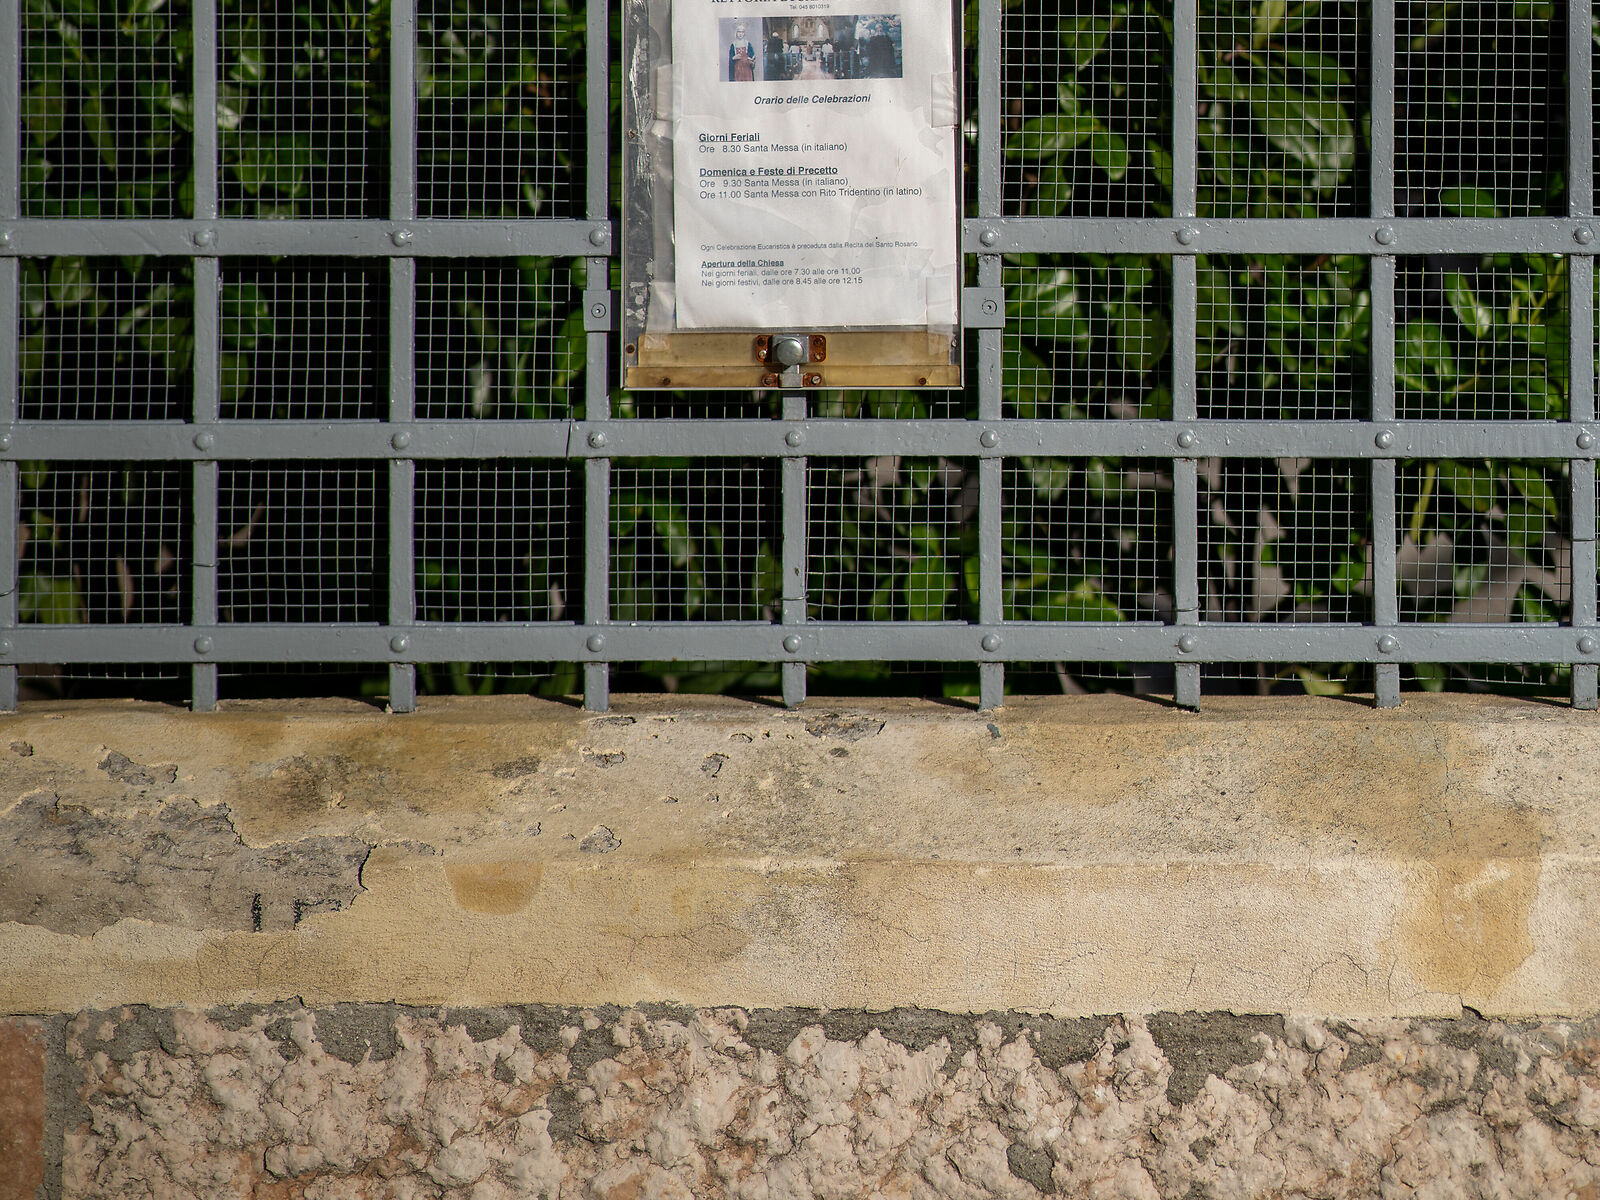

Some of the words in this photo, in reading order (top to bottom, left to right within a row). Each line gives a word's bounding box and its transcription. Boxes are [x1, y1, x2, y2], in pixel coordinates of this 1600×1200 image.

[754, 96, 784, 104] Orario
[786, 95, 809, 104] delle
[812, 94, 872, 104] Celebrazioni
[698, 133, 728, 142] Giorni
[730, 132, 760, 142] Feriali
[699, 144, 715, 153] Ore
[722, 144, 741, 152] 8.30
[744, 144, 768, 152] Santa
[770, 144, 799, 152] Messa
[801, 144, 812, 152] (in
[814, 142, 848, 152] italiano)
[700, 168, 747, 177] Domenica
[758, 167, 784, 176] Feste
[786, 166, 796, 176] di
[798, 166, 838, 175] Precetto
[700, 180, 716, 188] Ore
[723, 179, 742, 188] 9.30
[744, 178, 769, 187] Santa
[772, 178, 800, 186] Messa
[802, 178, 812, 187] (in
[815, 177, 848, 186] italiano)
[700, 190, 716, 199] Ore
[719, 190, 742, 198] 11.00
[744, 190, 768, 198] Santa
[771, 190, 799, 198] Messa
[820, 188, 836, 197] Rito
[838, 188, 881, 196] Tridentino
[883, 188, 894, 196] (in
[896, 186, 922, 196] latino)
[700, 244, 715, 252] Ogni
[797, 242, 827, 250] preceduta
[701, 260, 735, 268] Apertura
[716, 270, 736, 278] giorni
[716, 279, 736, 288] giorni
[738, 278, 760, 287] festivi,
[796, 277, 812, 285] 8.45
[842, 276, 863, 284] 12.15
